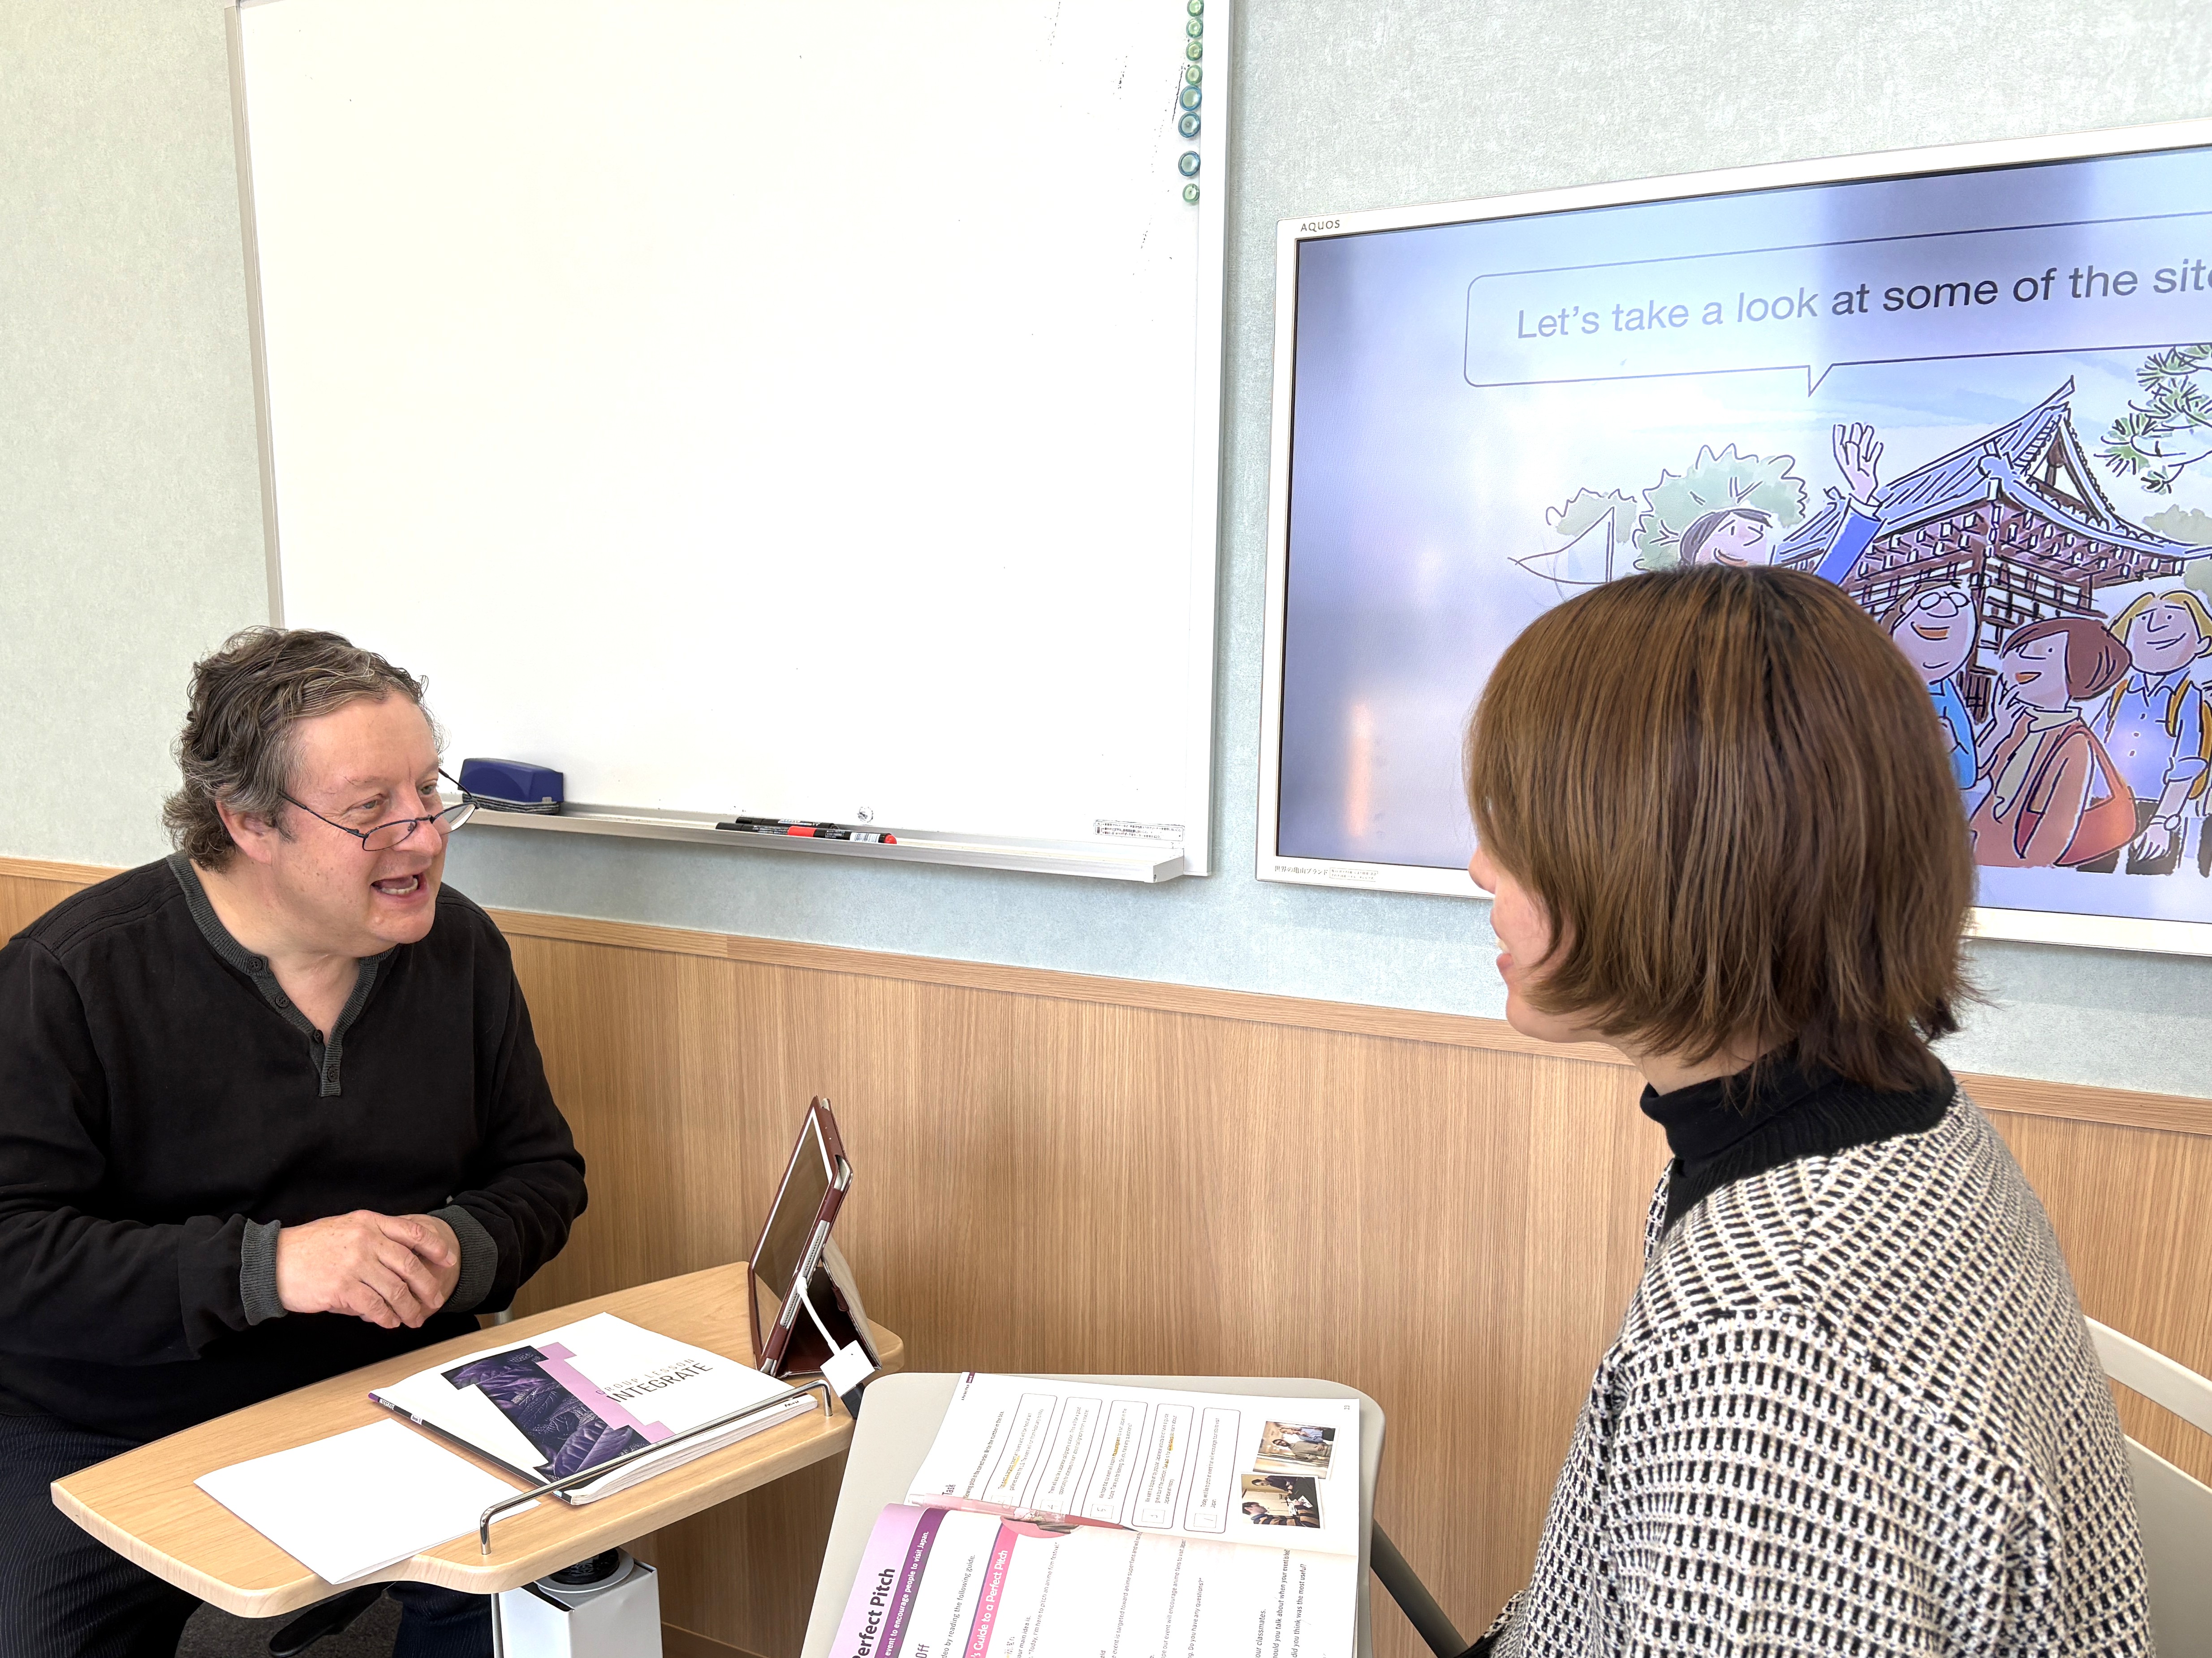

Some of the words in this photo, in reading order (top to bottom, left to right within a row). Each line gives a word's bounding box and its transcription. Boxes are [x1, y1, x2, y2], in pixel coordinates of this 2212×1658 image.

[1300, 219, 1341, 233] AQUOS
[1518, 306, 1599, 338] Let's
[1612, 300, 1689, 331] take
[1702, 302, 1723, 325] a
[1737, 287, 1818, 323] look
[1832, 284, 1870, 315] at
[1883, 280, 1998, 311] some
[2013, 267, 2057, 302] of
[2069, 265, 2138, 298] the
[2153, 258, 2212, 293] sit
[595, 1378, 638, 1395] GROUP
[644, 1359, 695, 1378] LESSON
[606, 1362, 713, 1402] INTEGRATE
[941, 1484, 956, 1495] Task
[917, 1531, 929, 1549] Japan.
[913, 1549, 923, 1562] visit
[966, 1555, 975, 1572] guide.
[994, 1550, 1008, 1570] Pitch
[870, 1568, 895, 1607] Pitch
[905, 1571, 916, 1593] people
[957, 1573, 971, 1600] following
[986, 1572, 1002, 1602] Perfect
[894, 1594, 909, 1628] encourage
[954, 1602, 962, 1612] the
[1120, 1593, 1128, 1610] toward
[1169, 1587, 1177, 1614] encourage
[1276, 1600, 1284, 1617] about
[948, 1614, 960, 1637] reading
[981, 1612, 992, 1622] to
[1116, 1611, 1125, 1633] targeted
[1255, 1609, 1266, 1646] classmates.
[1293, 1619, 1302, 1634] think
[885, 1638, 896, 1656] event
[973, 1624, 988, 1650] Guide
[915, 1643, 930, 1658] Off
